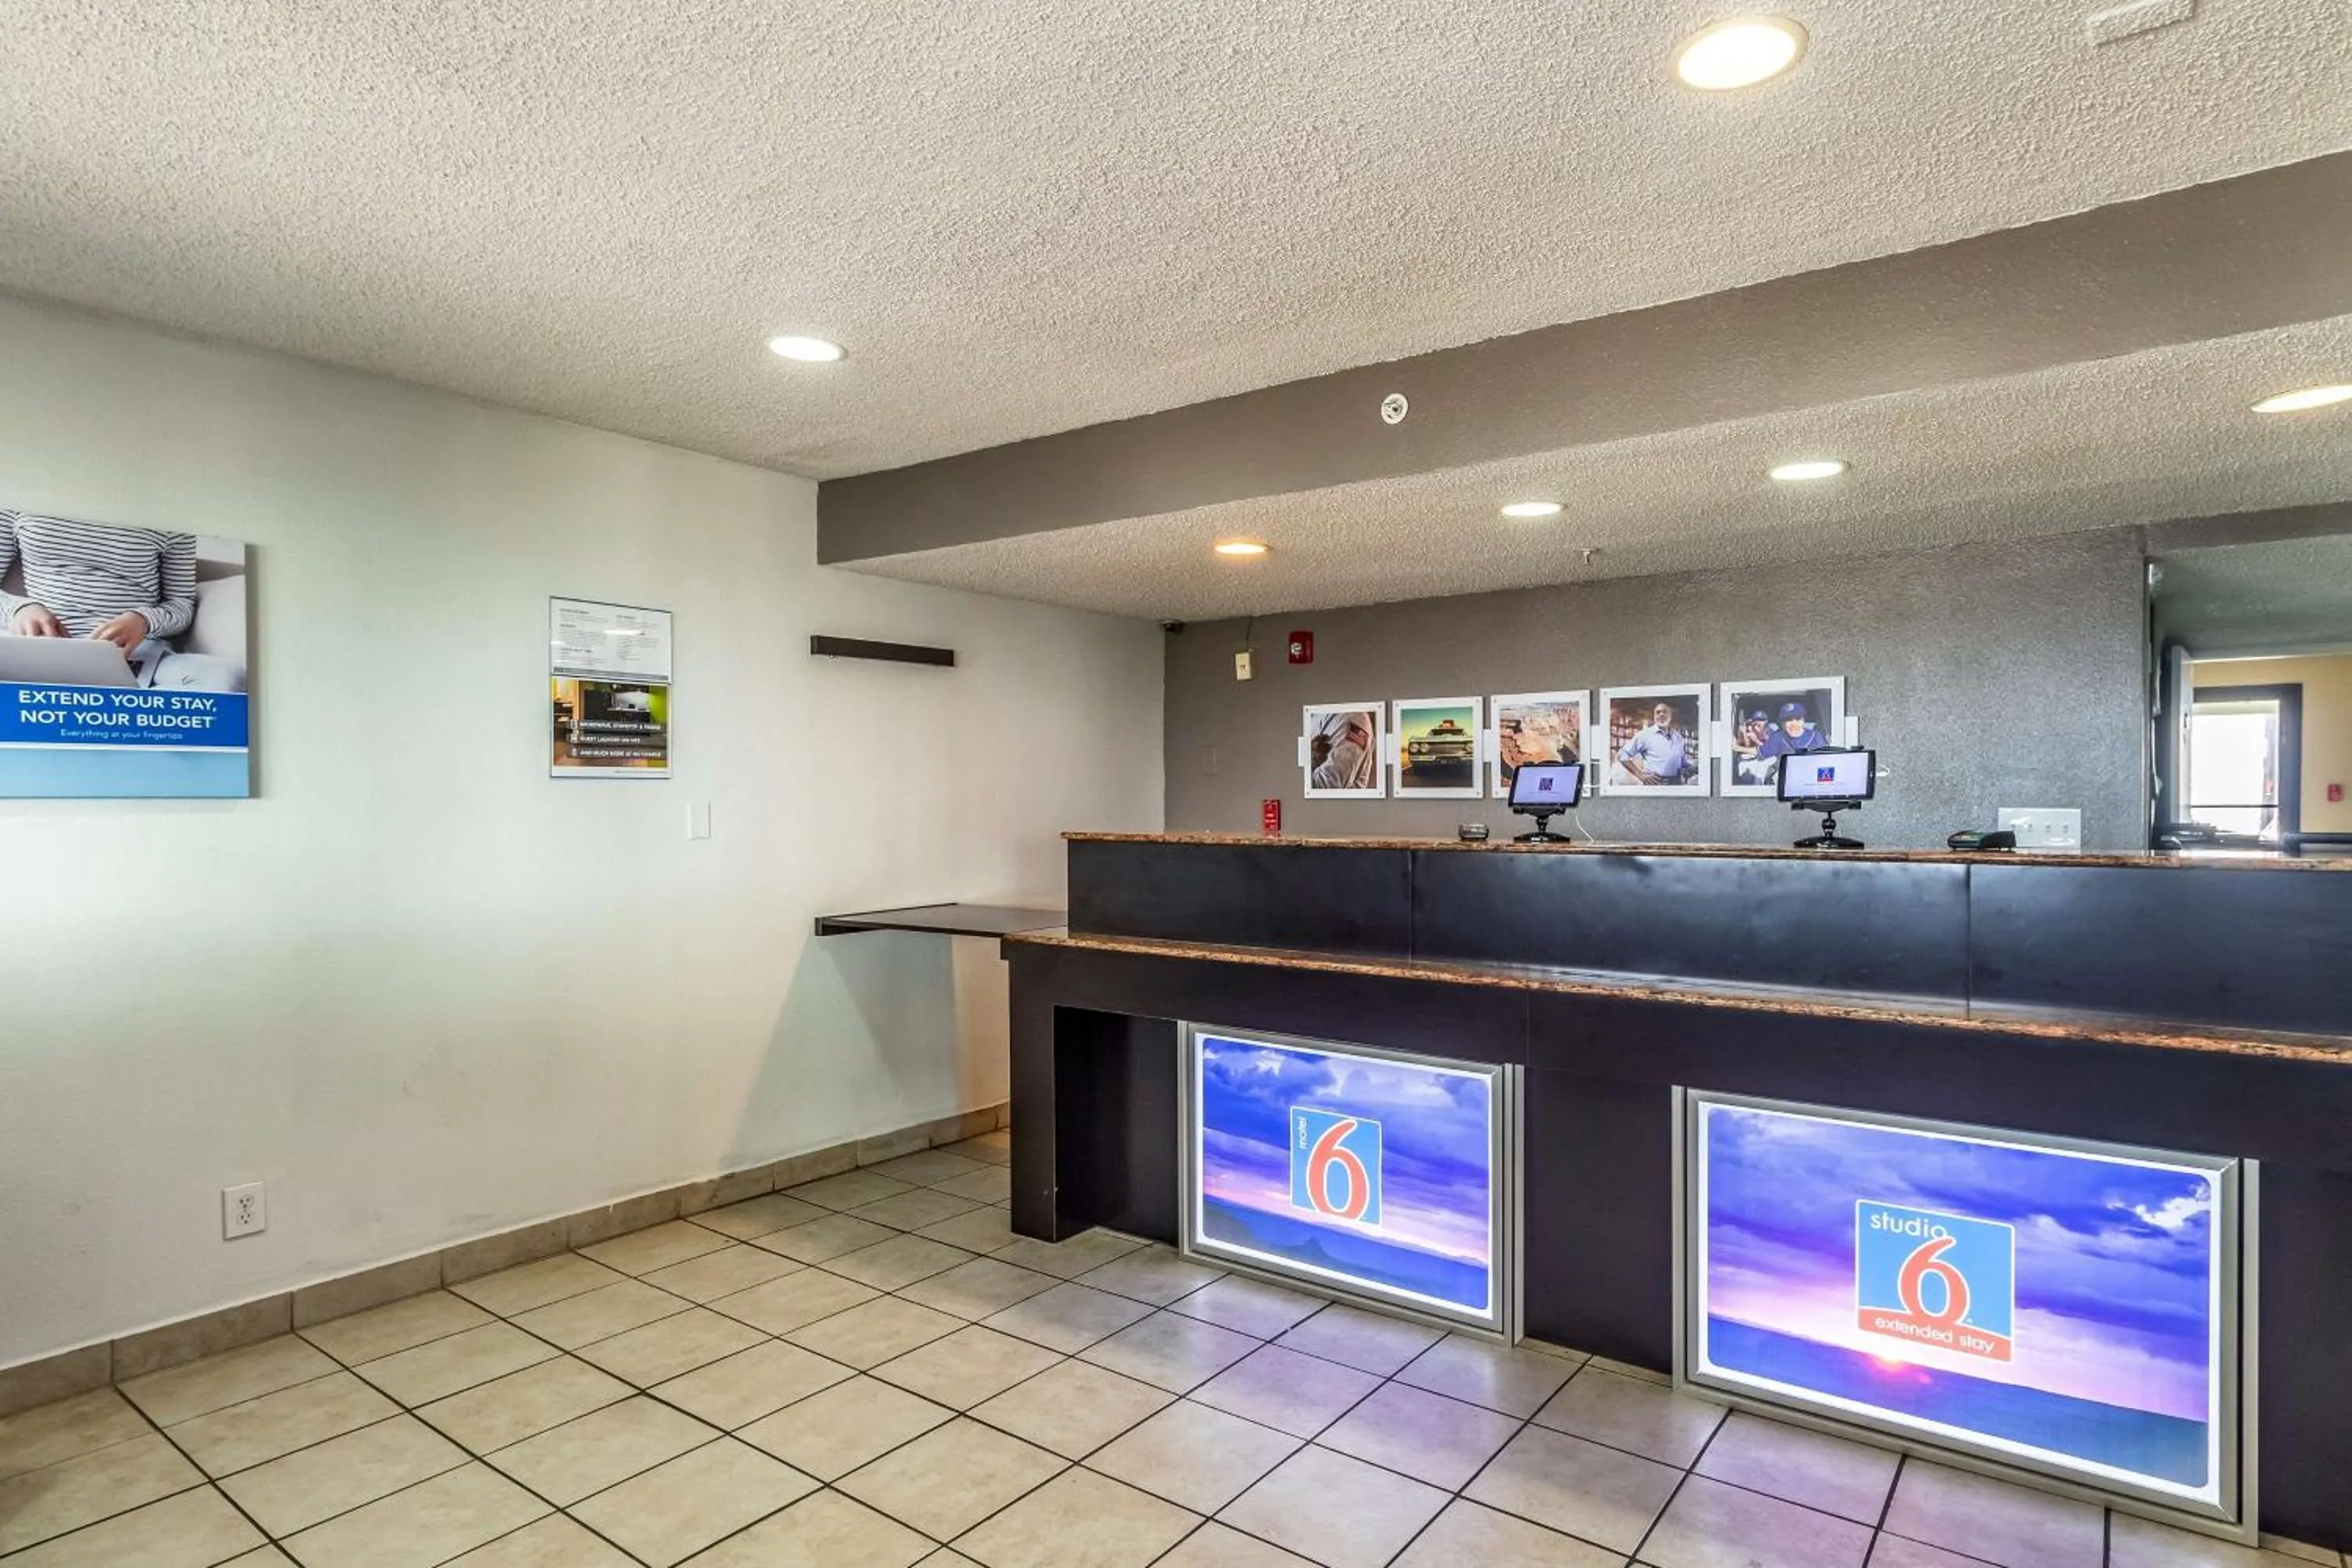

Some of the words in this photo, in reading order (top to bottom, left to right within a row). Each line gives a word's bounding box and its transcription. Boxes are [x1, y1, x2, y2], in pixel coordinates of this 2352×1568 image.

[18, 690, 104, 706] EXTEND
[110, 694, 165, 709] YOUR
[170, 696, 217, 713] STAY,
[20, 710, 67, 724] NOT
[73, 711, 130, 726] YOUR
[136, 713, 214, 728] BUDGET
[60, 728, 109, 739] Everything
[143, 730, 183, 741] fingertips
[1305, 1119, 1370, 1223] 6
[1870, 1211, 1947, 1239] studio
[1896, 1236, 1971, 1325] 6
[1875, 1316, 1954, 1344] extended
[1958, 1334, 1995, 1353] stay
